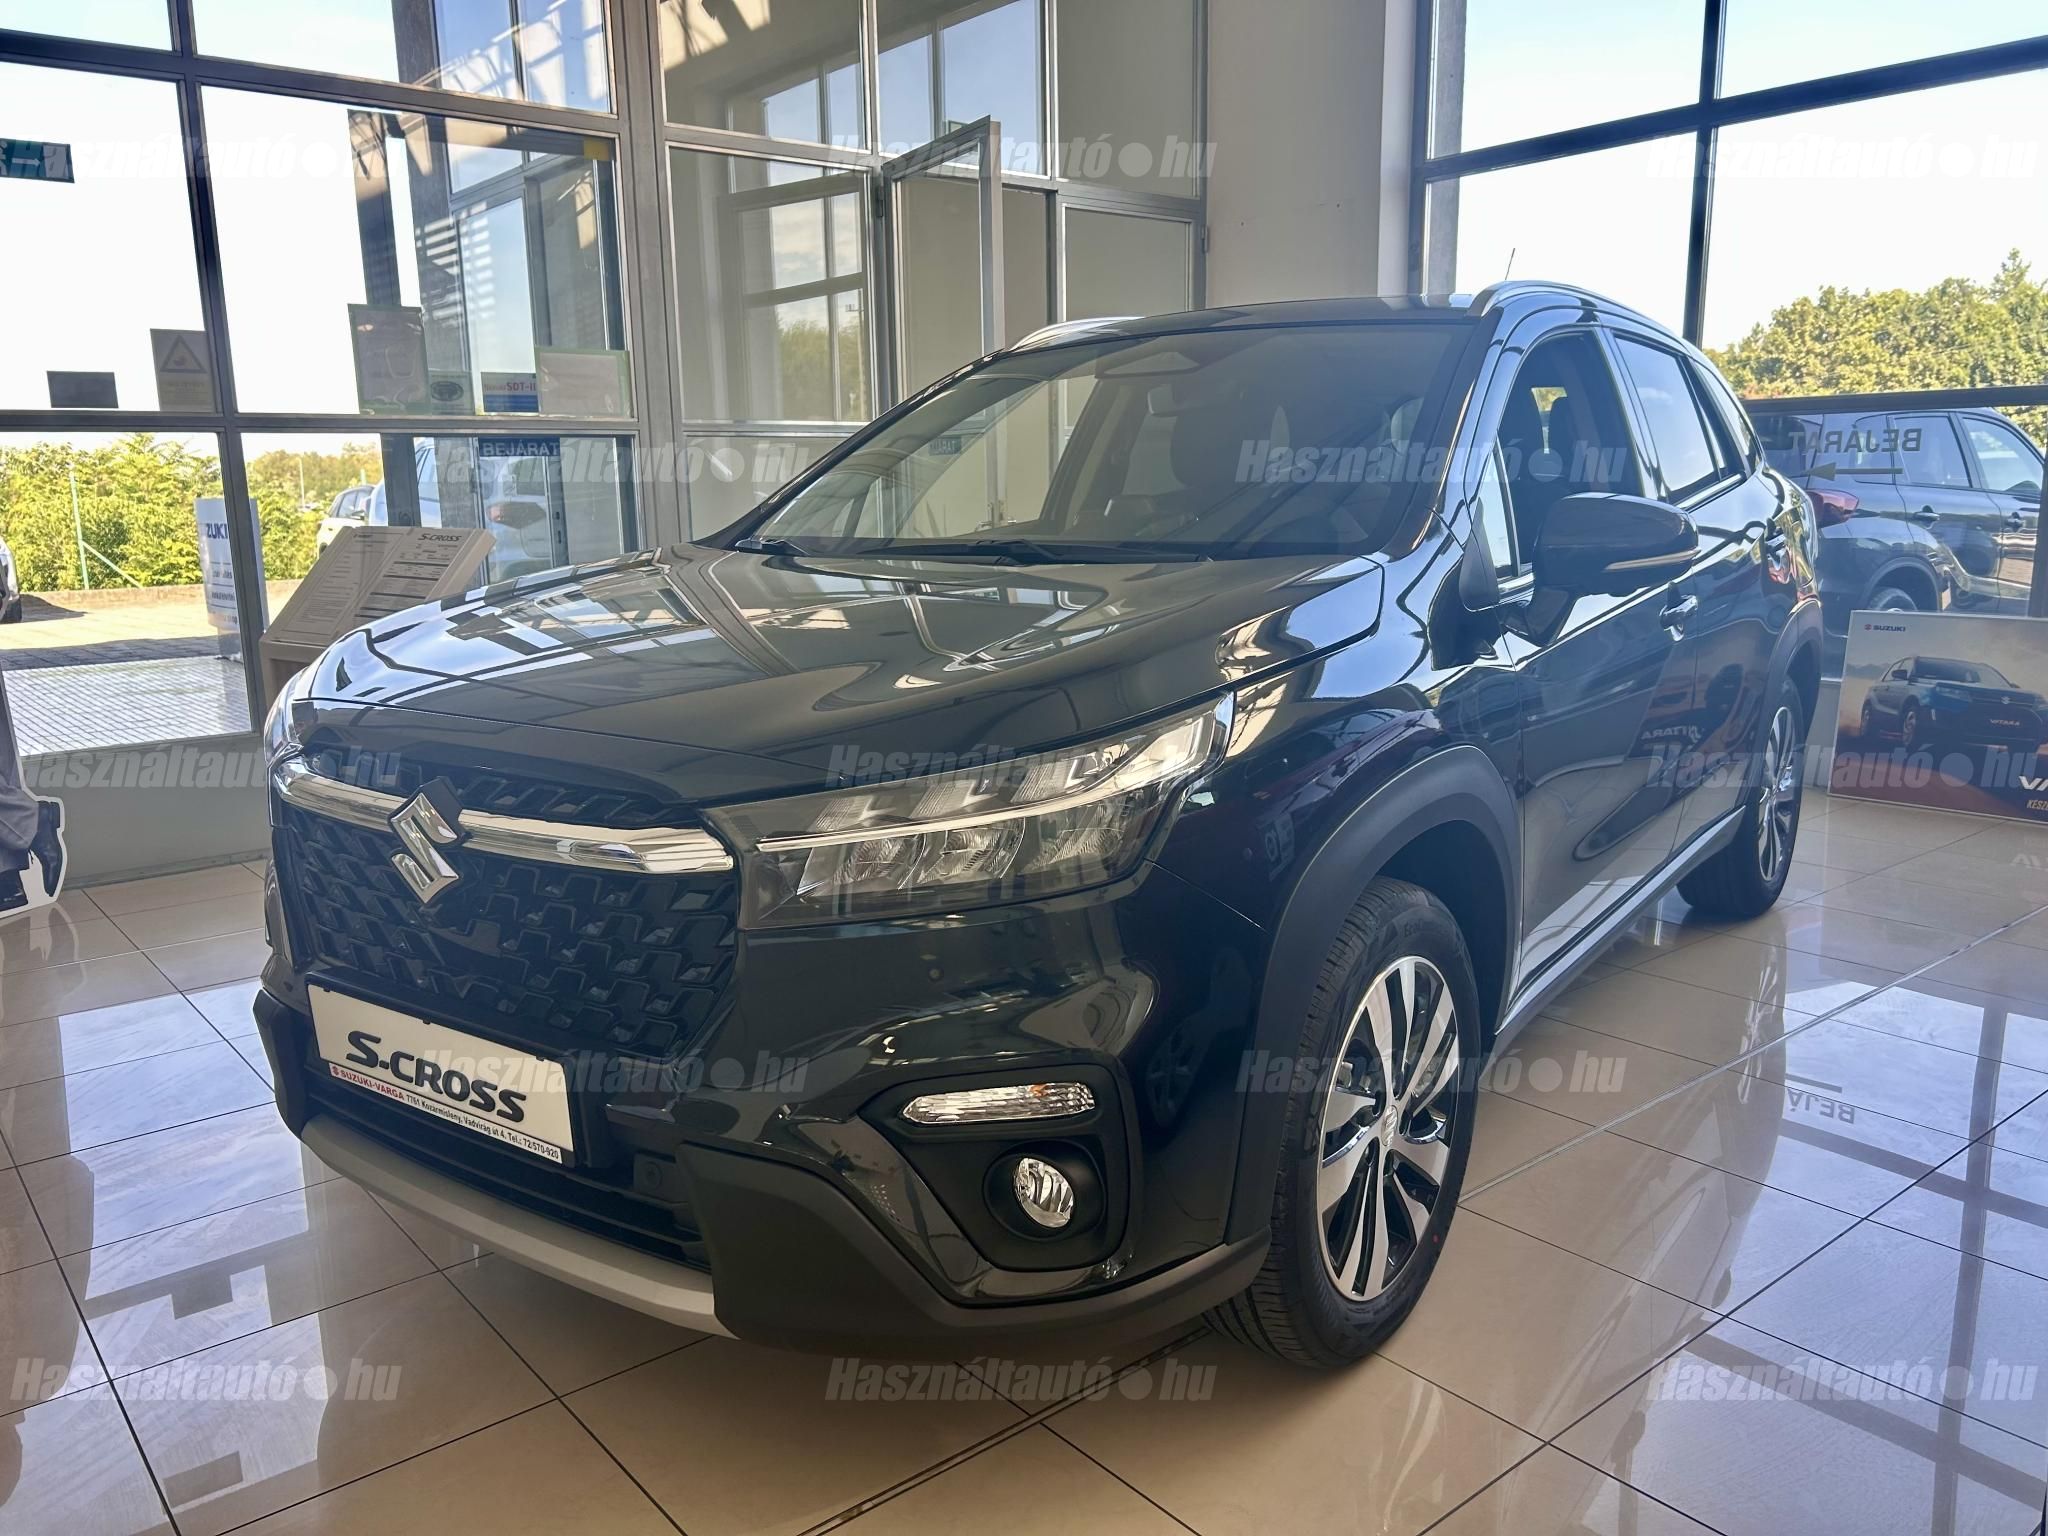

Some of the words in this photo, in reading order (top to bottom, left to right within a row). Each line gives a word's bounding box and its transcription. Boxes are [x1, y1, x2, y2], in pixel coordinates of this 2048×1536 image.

[483, 439, 559, 456] BEJÁRAT
[1873, 624, 1906, 632] SUZUKI
[340, 1069, 404, 1101] SUZUKI-VARGA
